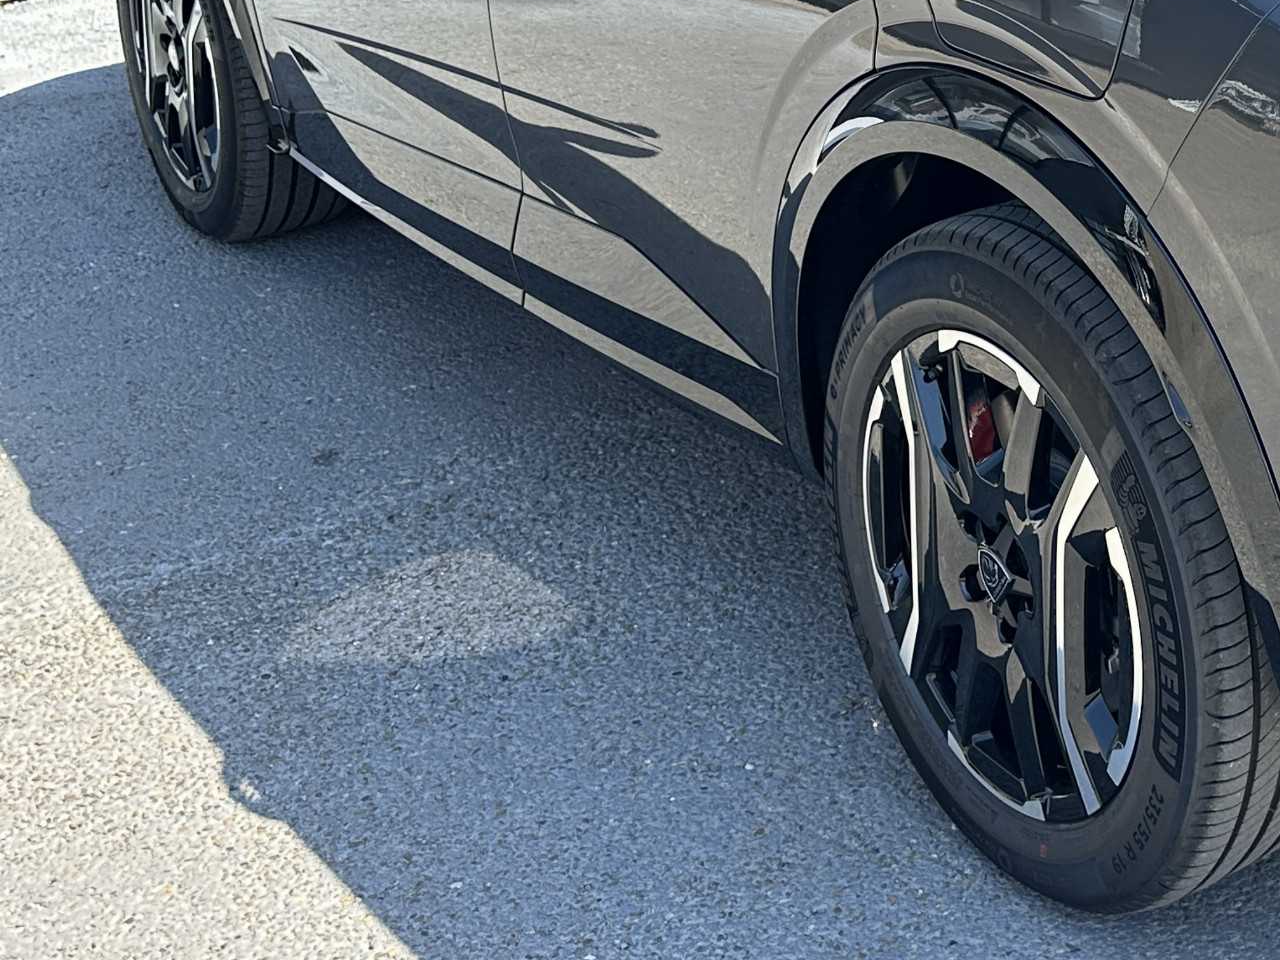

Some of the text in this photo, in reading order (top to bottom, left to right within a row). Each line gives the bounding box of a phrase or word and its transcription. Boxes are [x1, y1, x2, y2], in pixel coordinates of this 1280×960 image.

[1137, 540, 1181, 769] MICHELIN
[1112, 783, 1164, 875] 235/55 R 19
